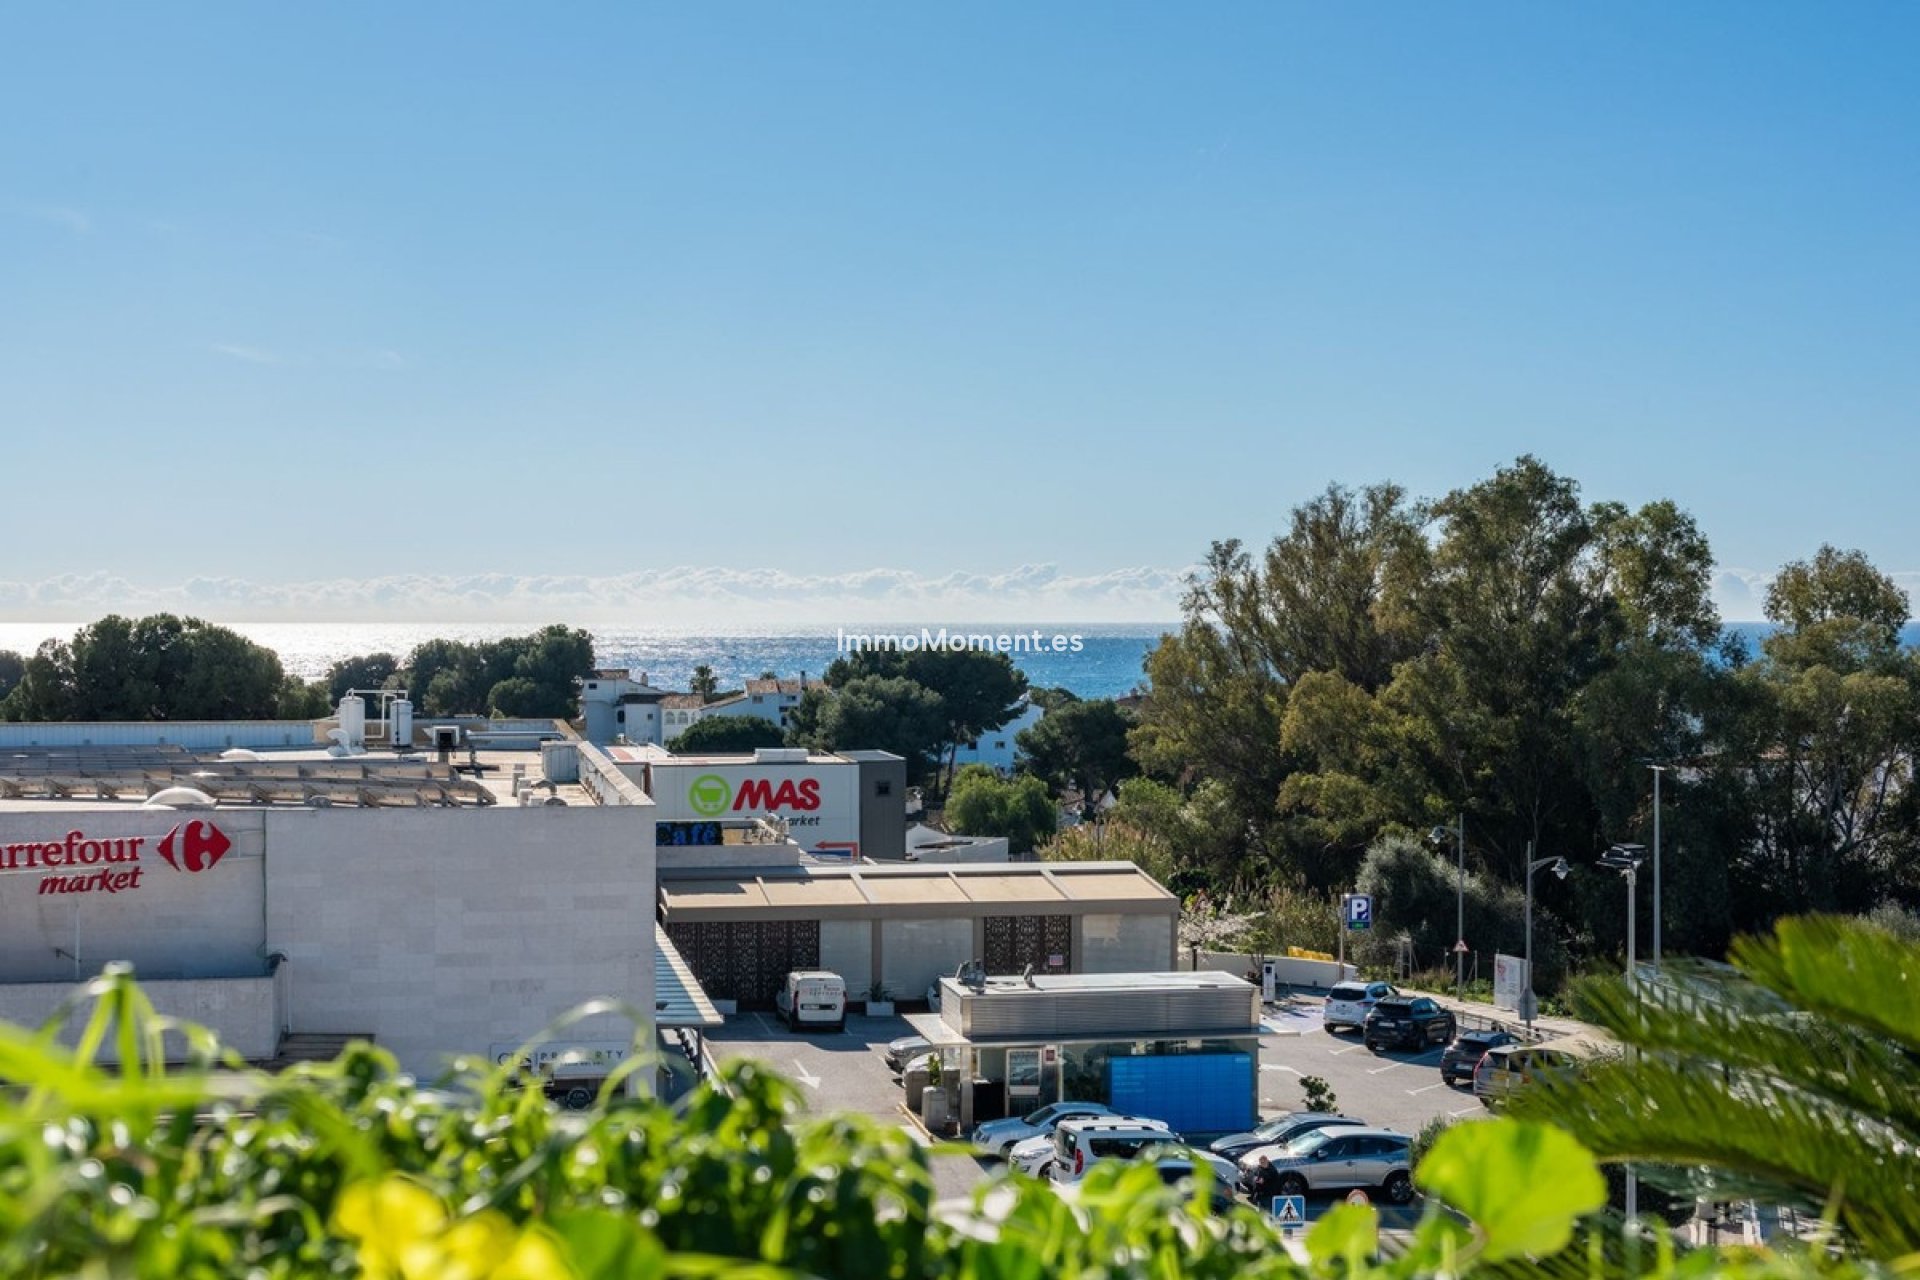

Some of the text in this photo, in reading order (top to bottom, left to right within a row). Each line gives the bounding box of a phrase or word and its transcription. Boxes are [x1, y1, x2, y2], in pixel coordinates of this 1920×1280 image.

[732, 778, 821, 811] MAS
[0, 830, 145, 869] rrefour
[38, 866, 144, 895] market
[1351, 898, 1367, 920] P
